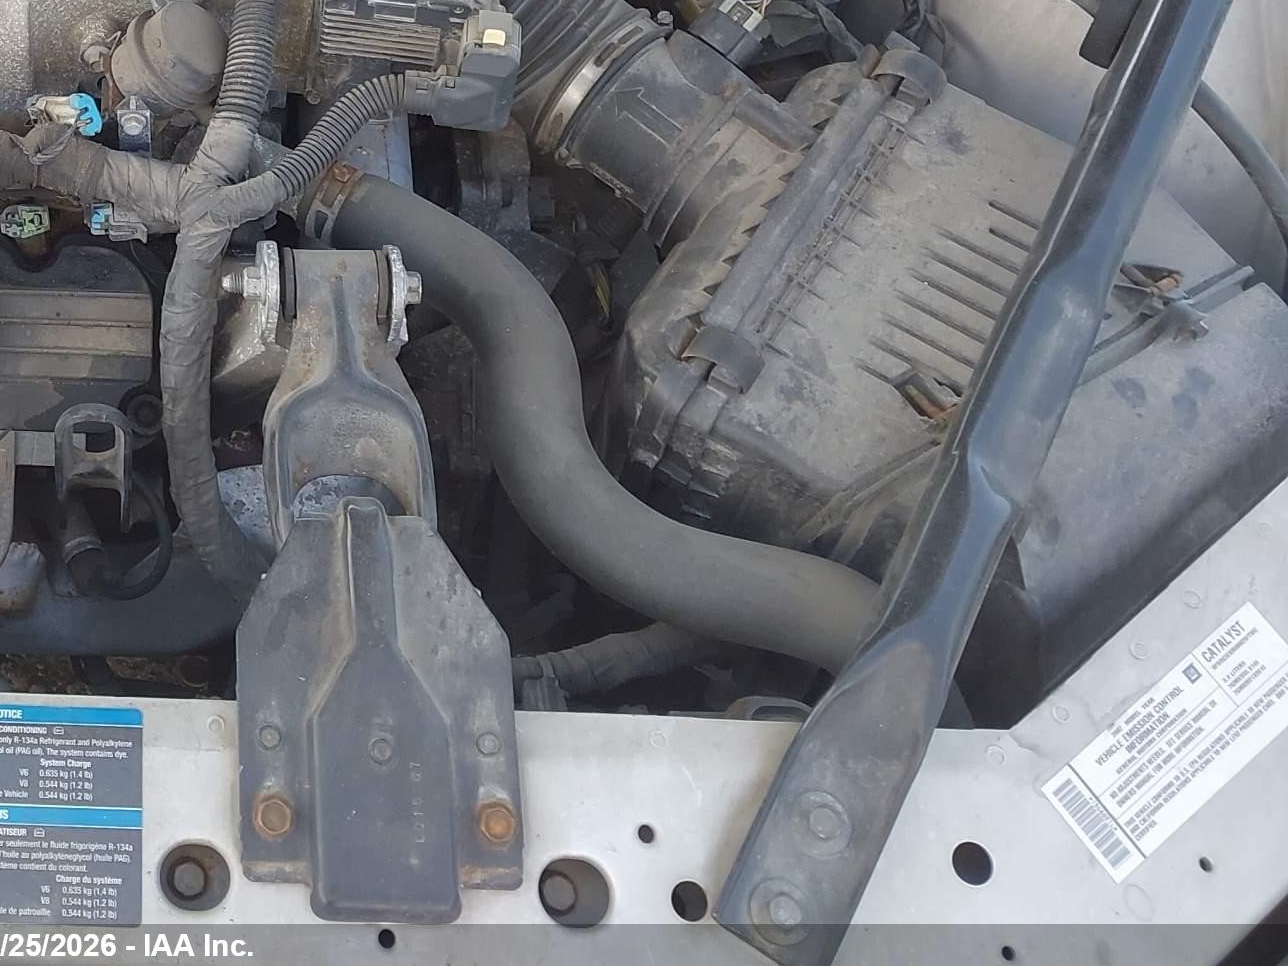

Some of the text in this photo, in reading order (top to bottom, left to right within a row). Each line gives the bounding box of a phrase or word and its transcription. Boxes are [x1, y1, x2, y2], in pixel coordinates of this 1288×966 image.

[1201, 620, 1245, 663] CATALYST
[1094, 683, 1185, 767] VEHICLE EMISSION CONTROL
[1123, 710, 1171, 754] INFORMATION
[40, 759, 91, 768] System Charge
